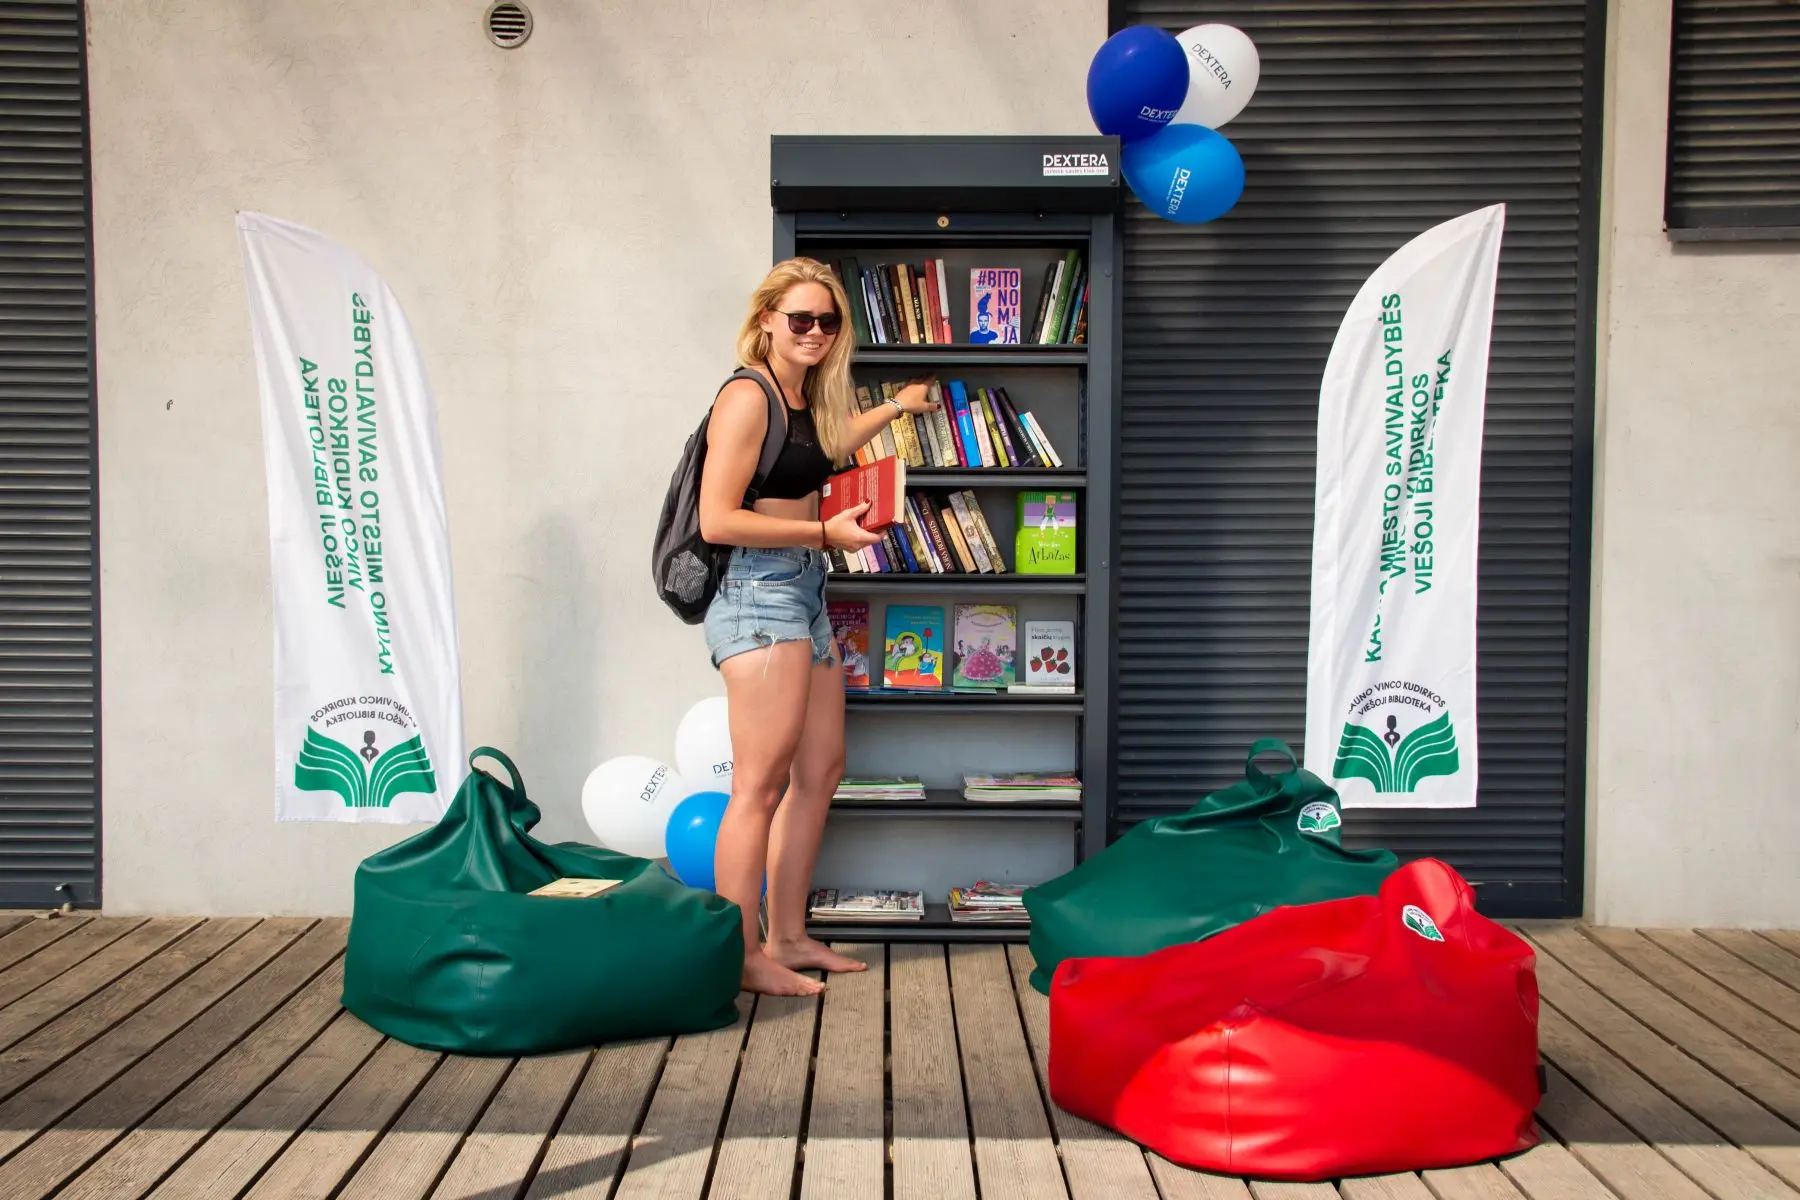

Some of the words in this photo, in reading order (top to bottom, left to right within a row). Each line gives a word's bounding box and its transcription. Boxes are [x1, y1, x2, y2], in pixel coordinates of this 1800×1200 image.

[1192, 43, 1231, 90] DEXTERA
[1043, 153, 1108, 167] DEXTERA
[1168, 168, 1191, 215] DEXTERA
[977, 270, 1019, 288] #BITO
[998, 289, 1019, 307] NO
[1003, 326, 1019, 344] JA
[1378, 293, 1404, 476] SAVIVALDYBĖS
[928, 520, 944, 551] ROBERTS
[1379, 484, 1402, 572] MIESTO
[941, 549, 953, 570] NORA
[1410, 501, 1434, 595] VIEŠOJI
[1358, 696, 1387, 716] VIEŠOJI
[1388, 695, 1432, 713] BIBLIOTEKA
[1374, 680, 1401, 692] VINCO
[1402, 681, 1446, 708] KUDIRKOS
